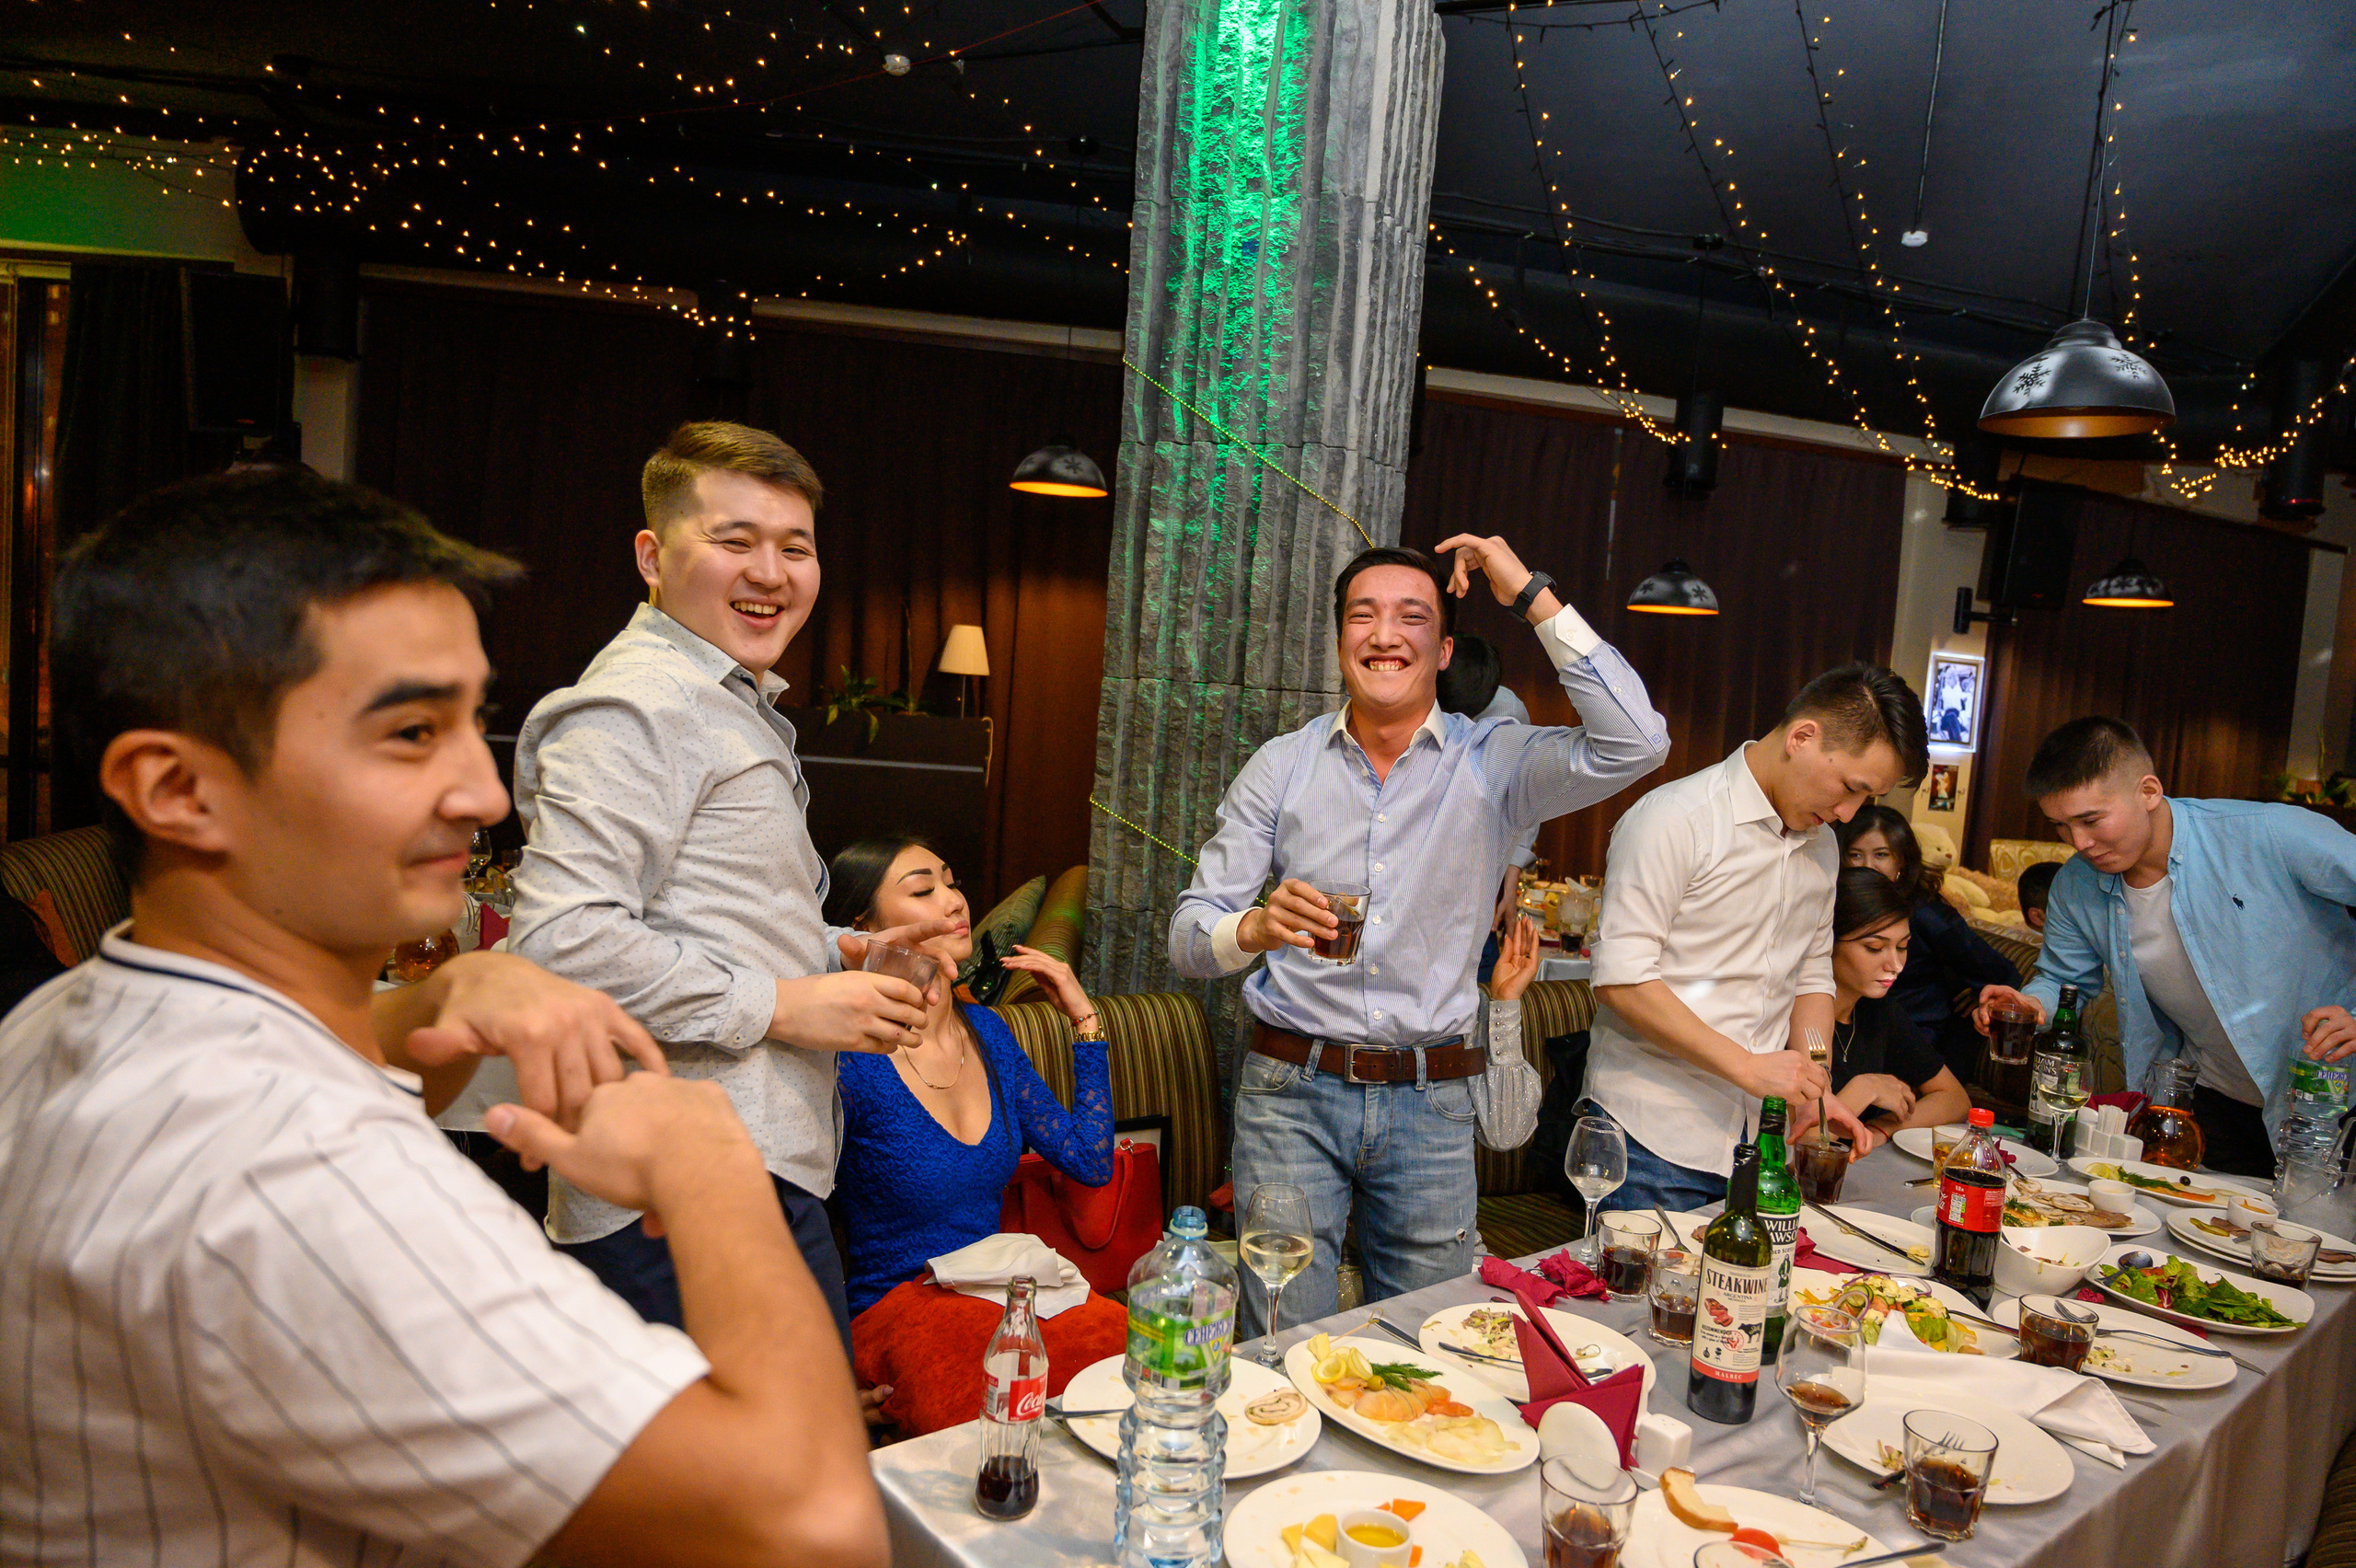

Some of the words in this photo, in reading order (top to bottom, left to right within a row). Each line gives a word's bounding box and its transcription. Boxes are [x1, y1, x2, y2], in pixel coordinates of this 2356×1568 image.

[1769, 1229, 1796, 1243] AWSO
[1705, 1268, 1768, 1294] STEAKWINE
[1724, 1292, 1752, 1300] ARGENTINA
[1715, 1370, 1743, 1380] MALBEC
